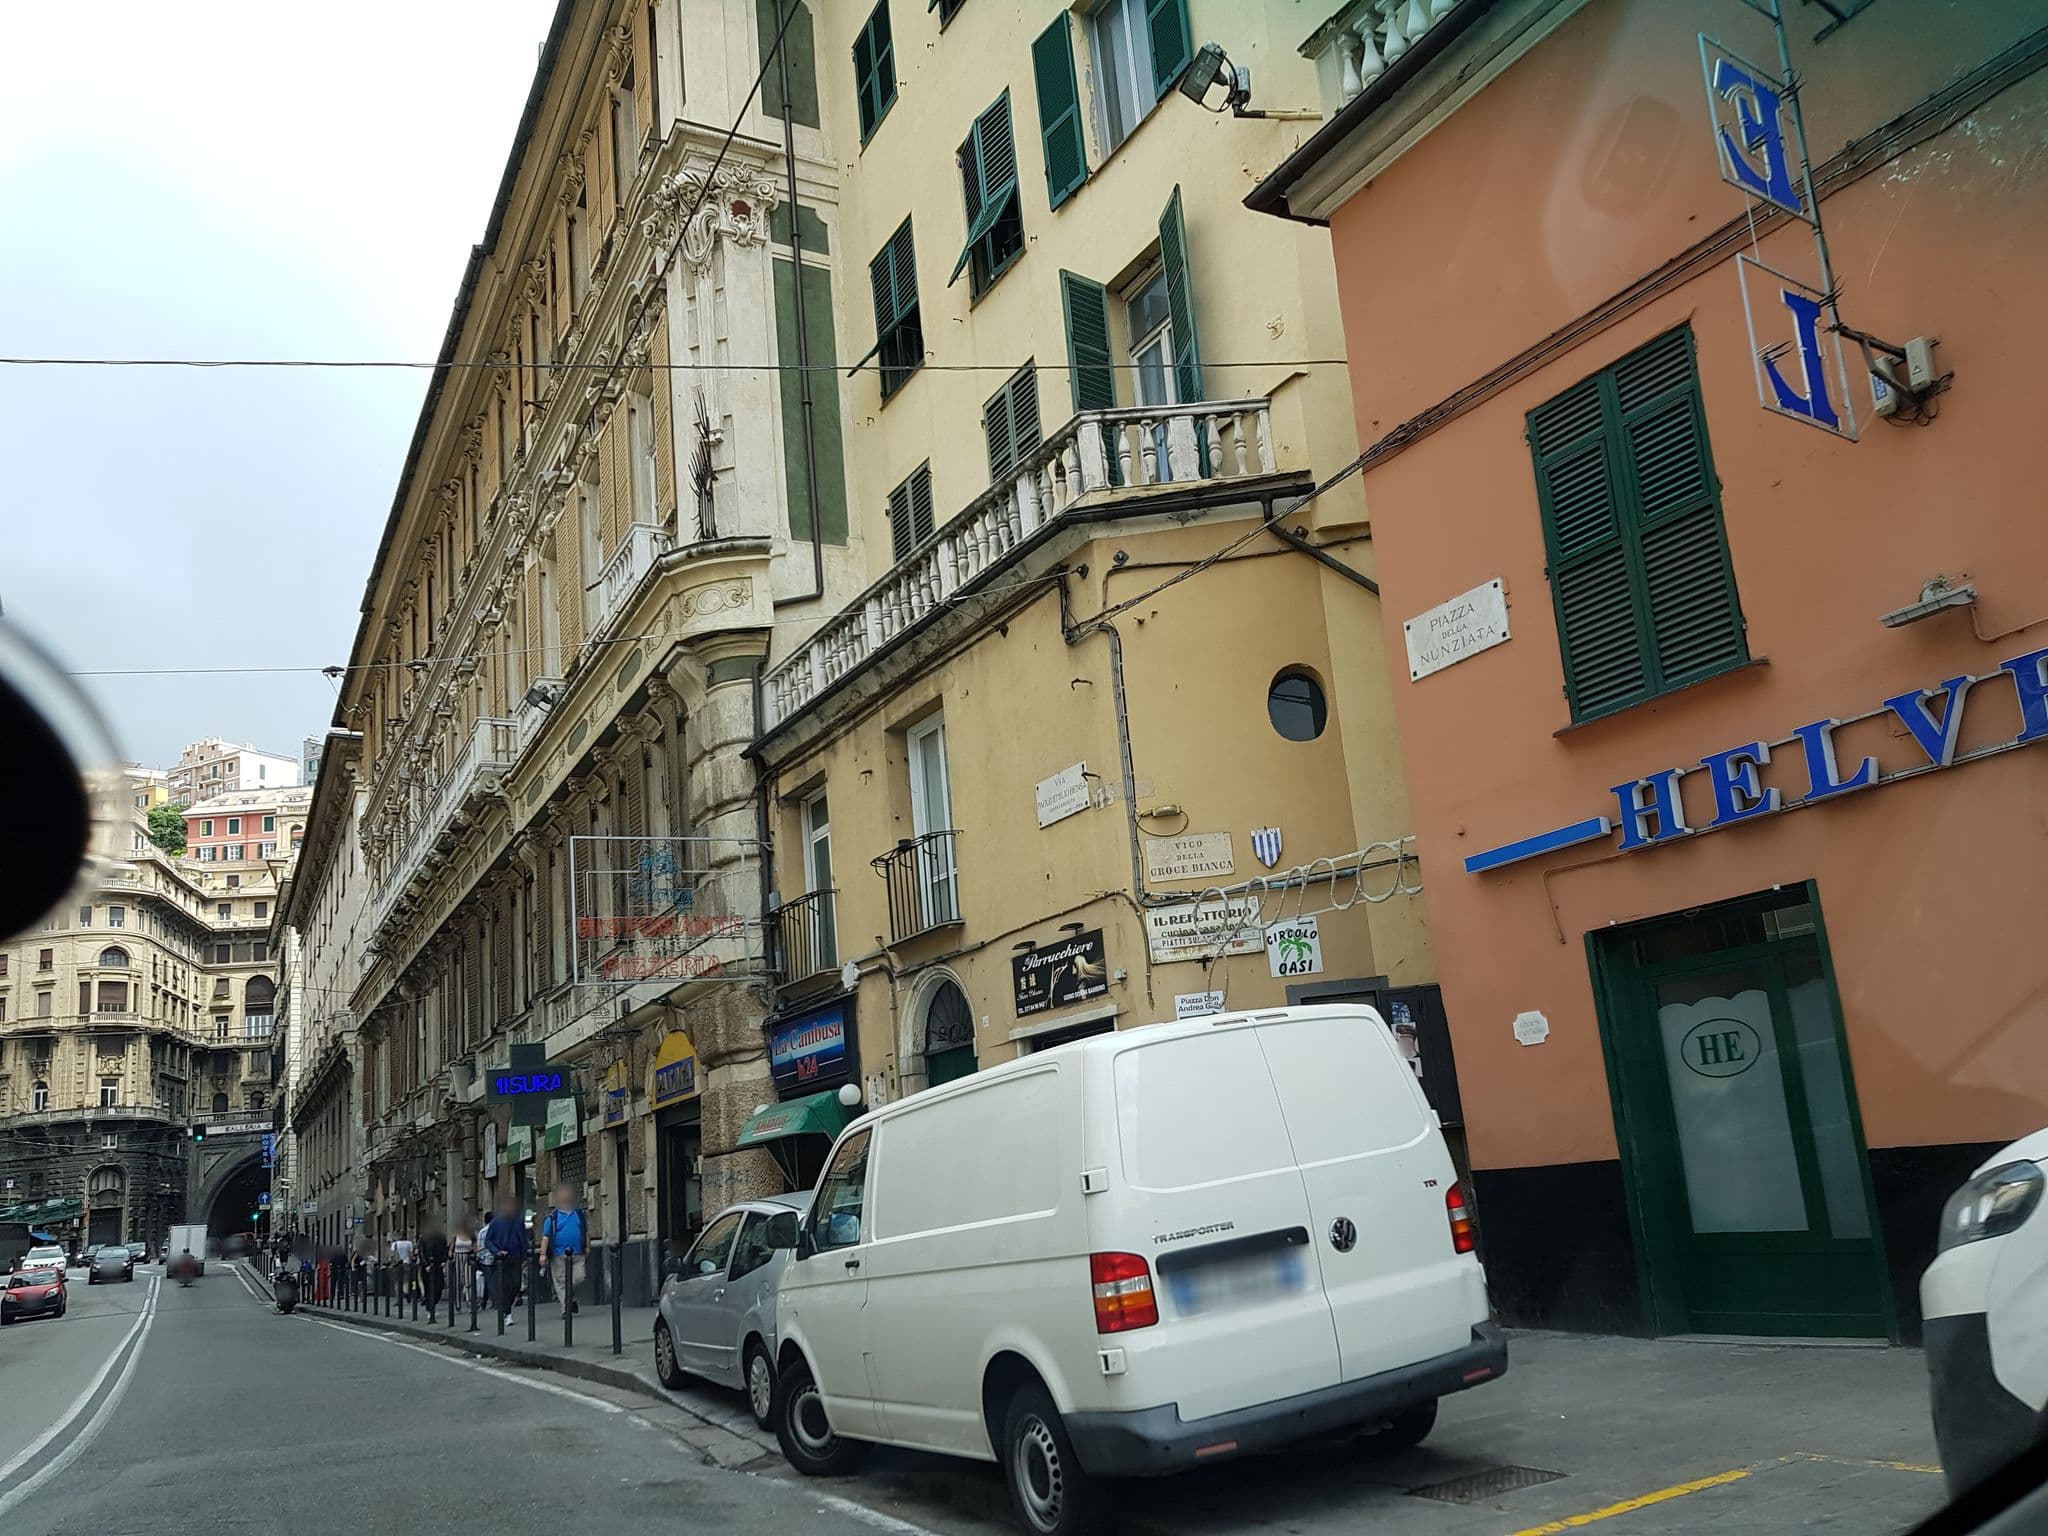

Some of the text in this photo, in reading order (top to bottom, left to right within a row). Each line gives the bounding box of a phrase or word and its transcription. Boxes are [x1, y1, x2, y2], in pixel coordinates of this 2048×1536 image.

[1429, 602, 1475, 632] PIAZZA
[1441, 623, 1468, 640] DELLA
[1418, 625, 1496, 667] NUNZIATA
[1054, 777, 1067, 788] VIA
[1174, 840, 1204, 850] VICO
[1176, 852, 1205, 861] DELLA
[1150, 860, 1234, 877] CROCE BIANCA
[577, 915, 745, 941] RISTORANTE
[1161, 927, 1197, 938] cucina
[1161, 938, 1186, 948] PIATTI
[1267, 928, 1317, 946] CIRCOLO
[601, 955, 726, 981] PIZZERIA
[1279, 959, 1312, 975] OASI
[1179, 1004, 1204, 1012] Andrea
[1181, 995, 1220, 1005] Piazza Don
[773, 1021, 841, 1056] La Cambusa
[1696, 1031, 1745, 1066] HE
[1423, 1179, 1438, 1188] TDI
[1152, 1221, 1234, 1244] TRANSPORTER
